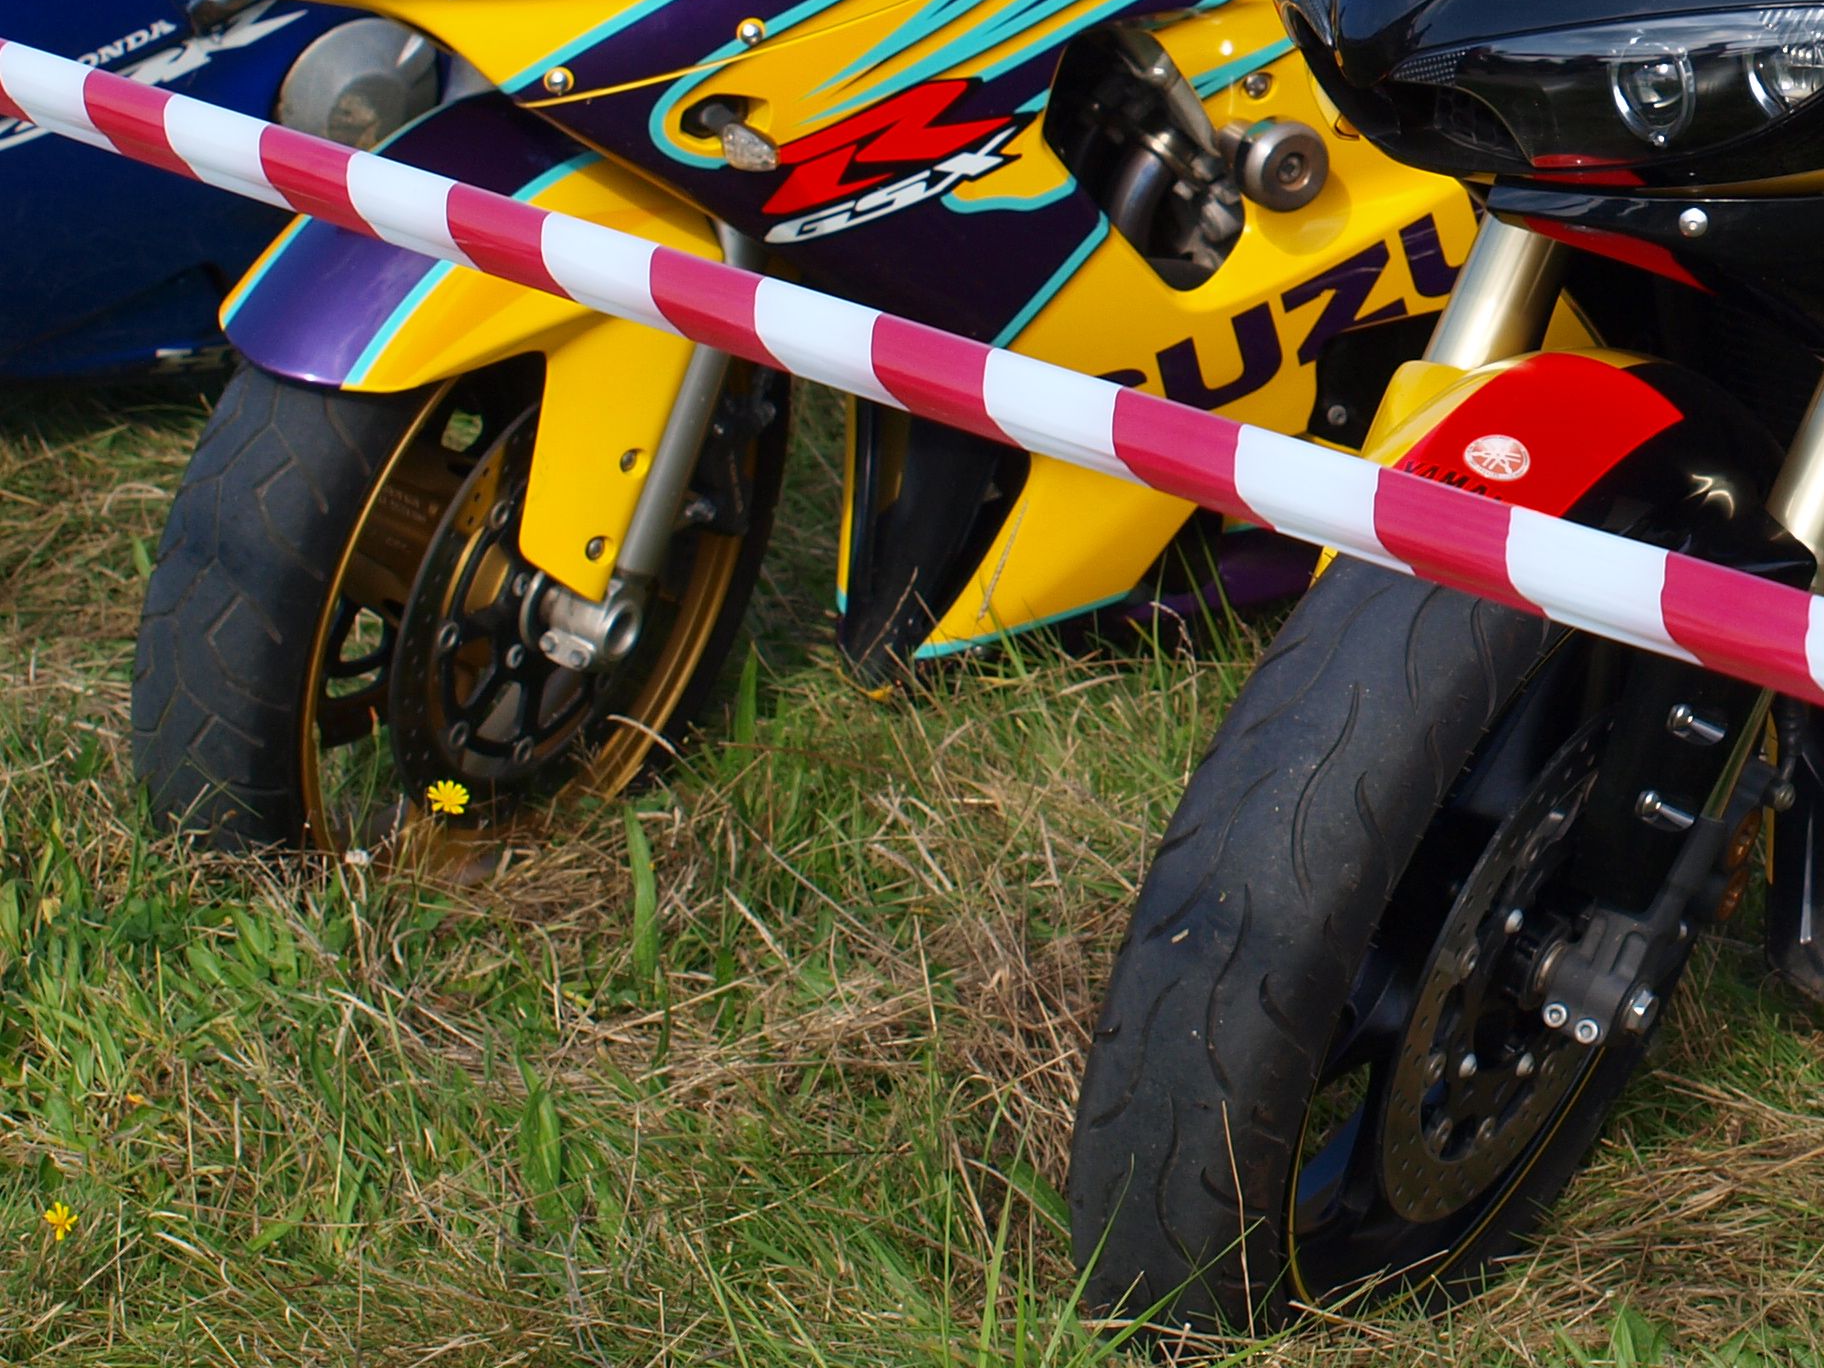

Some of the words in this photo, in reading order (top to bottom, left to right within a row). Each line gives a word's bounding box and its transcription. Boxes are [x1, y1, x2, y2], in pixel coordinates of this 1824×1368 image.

[76, 19, 177, 68] ONDA
[763, 125, 1018, 244] GSX
[1094, 201, 1485, 412] UZU
[1403, 461, 1504, 501] YAMA
